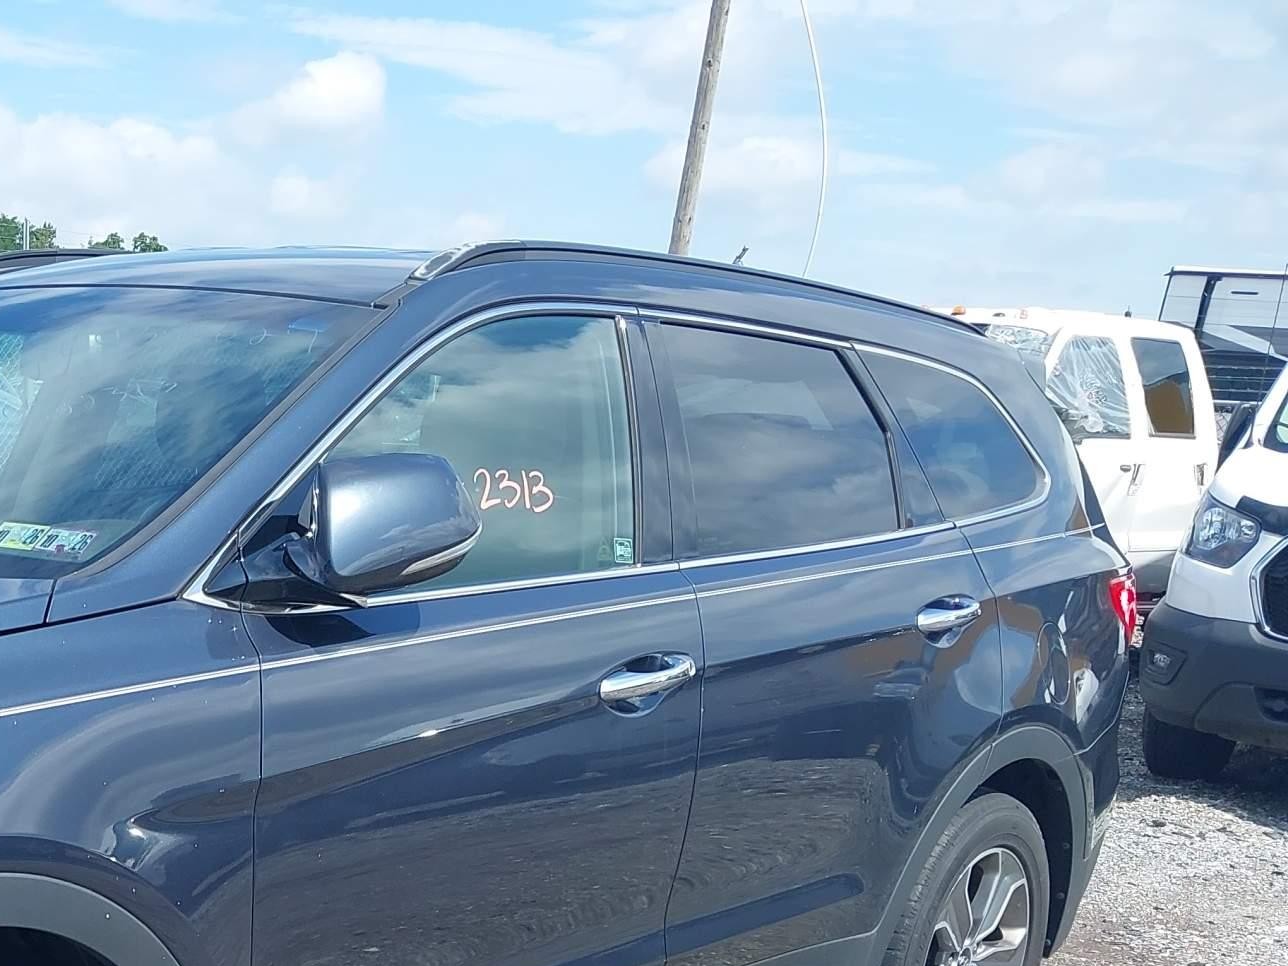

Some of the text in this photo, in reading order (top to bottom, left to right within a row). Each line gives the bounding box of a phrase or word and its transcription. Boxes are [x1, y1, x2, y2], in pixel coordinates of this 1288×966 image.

[473, 467, 555, 513] 2313
[22, 528, 45, 545] 26
[40, 533, 93, 551] 10 26
